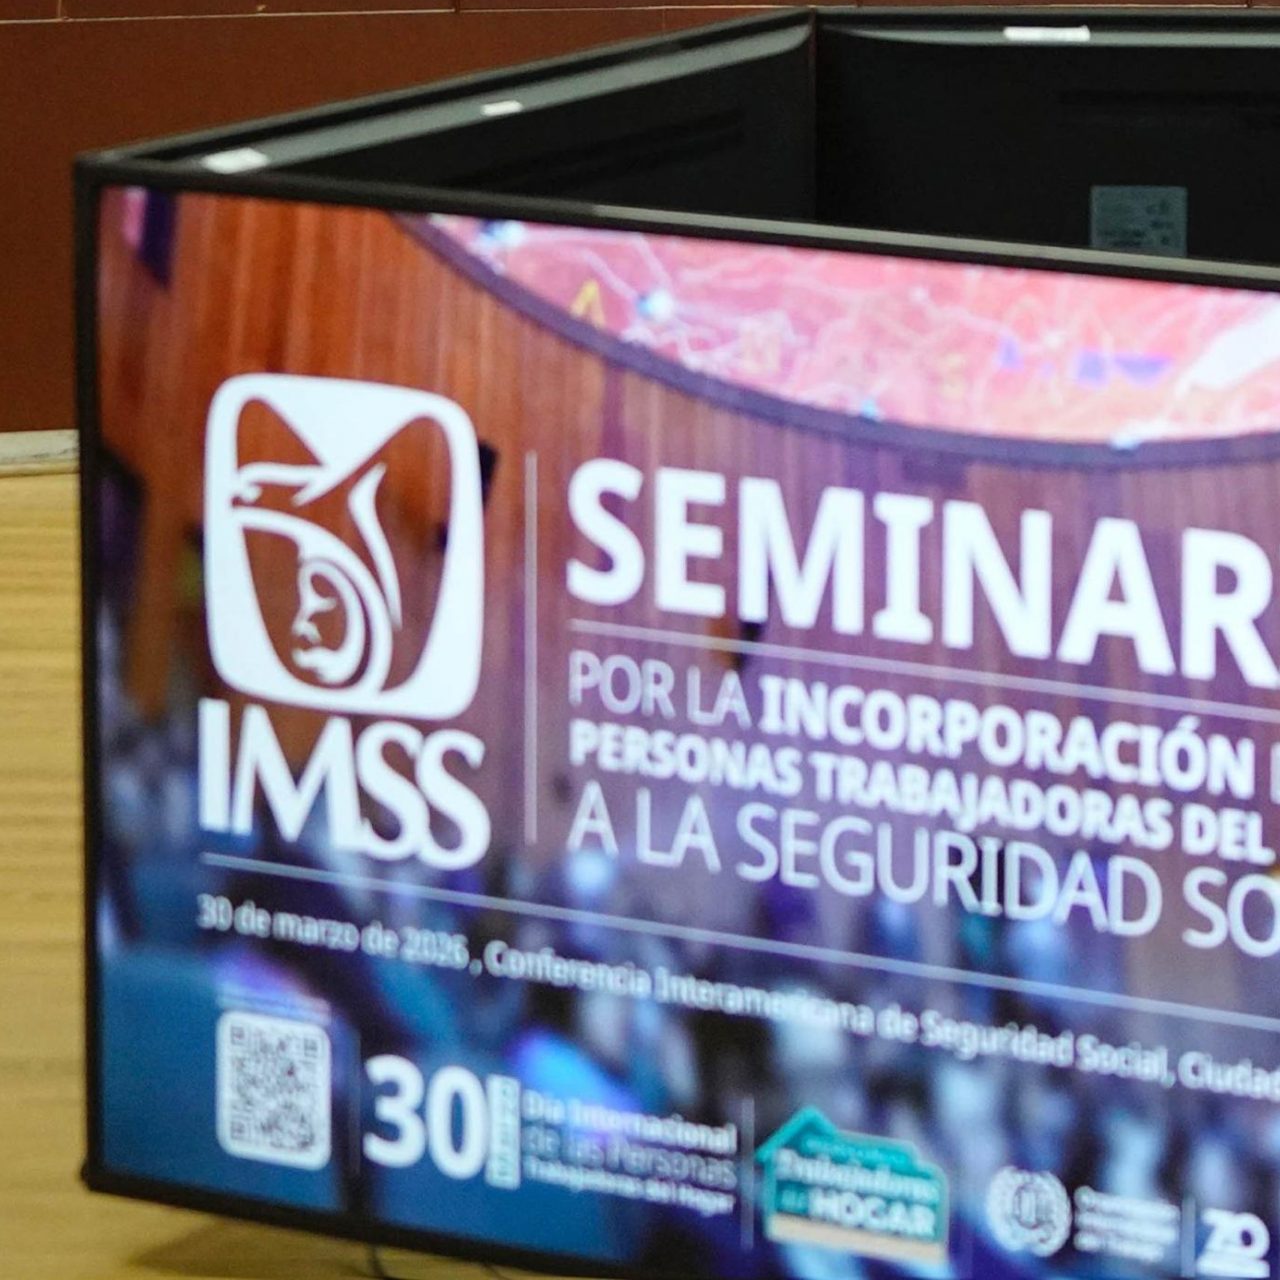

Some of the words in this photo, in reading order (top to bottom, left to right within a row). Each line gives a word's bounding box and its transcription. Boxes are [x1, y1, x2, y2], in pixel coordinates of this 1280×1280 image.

[200, 697, 492, 870] IMSS
[568, 649, 675, 719] POR
[687, 664, 752, 730] LA
[758, 674, 1255, 799] INCORPORACIÓN
[568, 718, 804, 797] PERSONAS
[808, 751, 1173, 849] TRABAJADORAS
[1182, 803, 1275, 865] DEL
[566, 780, 619, 857] A
[636, 787, 722, 875] LA
[736, 802, 1162, 936] SEGURIDAD
[197, 893, 233, 931] 30
[234, 900, 271, 938] de
[272, 911, 359, 952] marzo
[360, 920, 399, 958] de
[484, 940, 651, 997] Conferencia
[653, 966, 874, 1035] Interamericana
[876, 1002, 918, 1043] de
[920, 1009, 1074, 1067] Seguridad
[1075, 1033, 1176, 1088] Social,
[363, 1054, 486, 1180] 30
[606, 1136, 737, 1188] Personas
